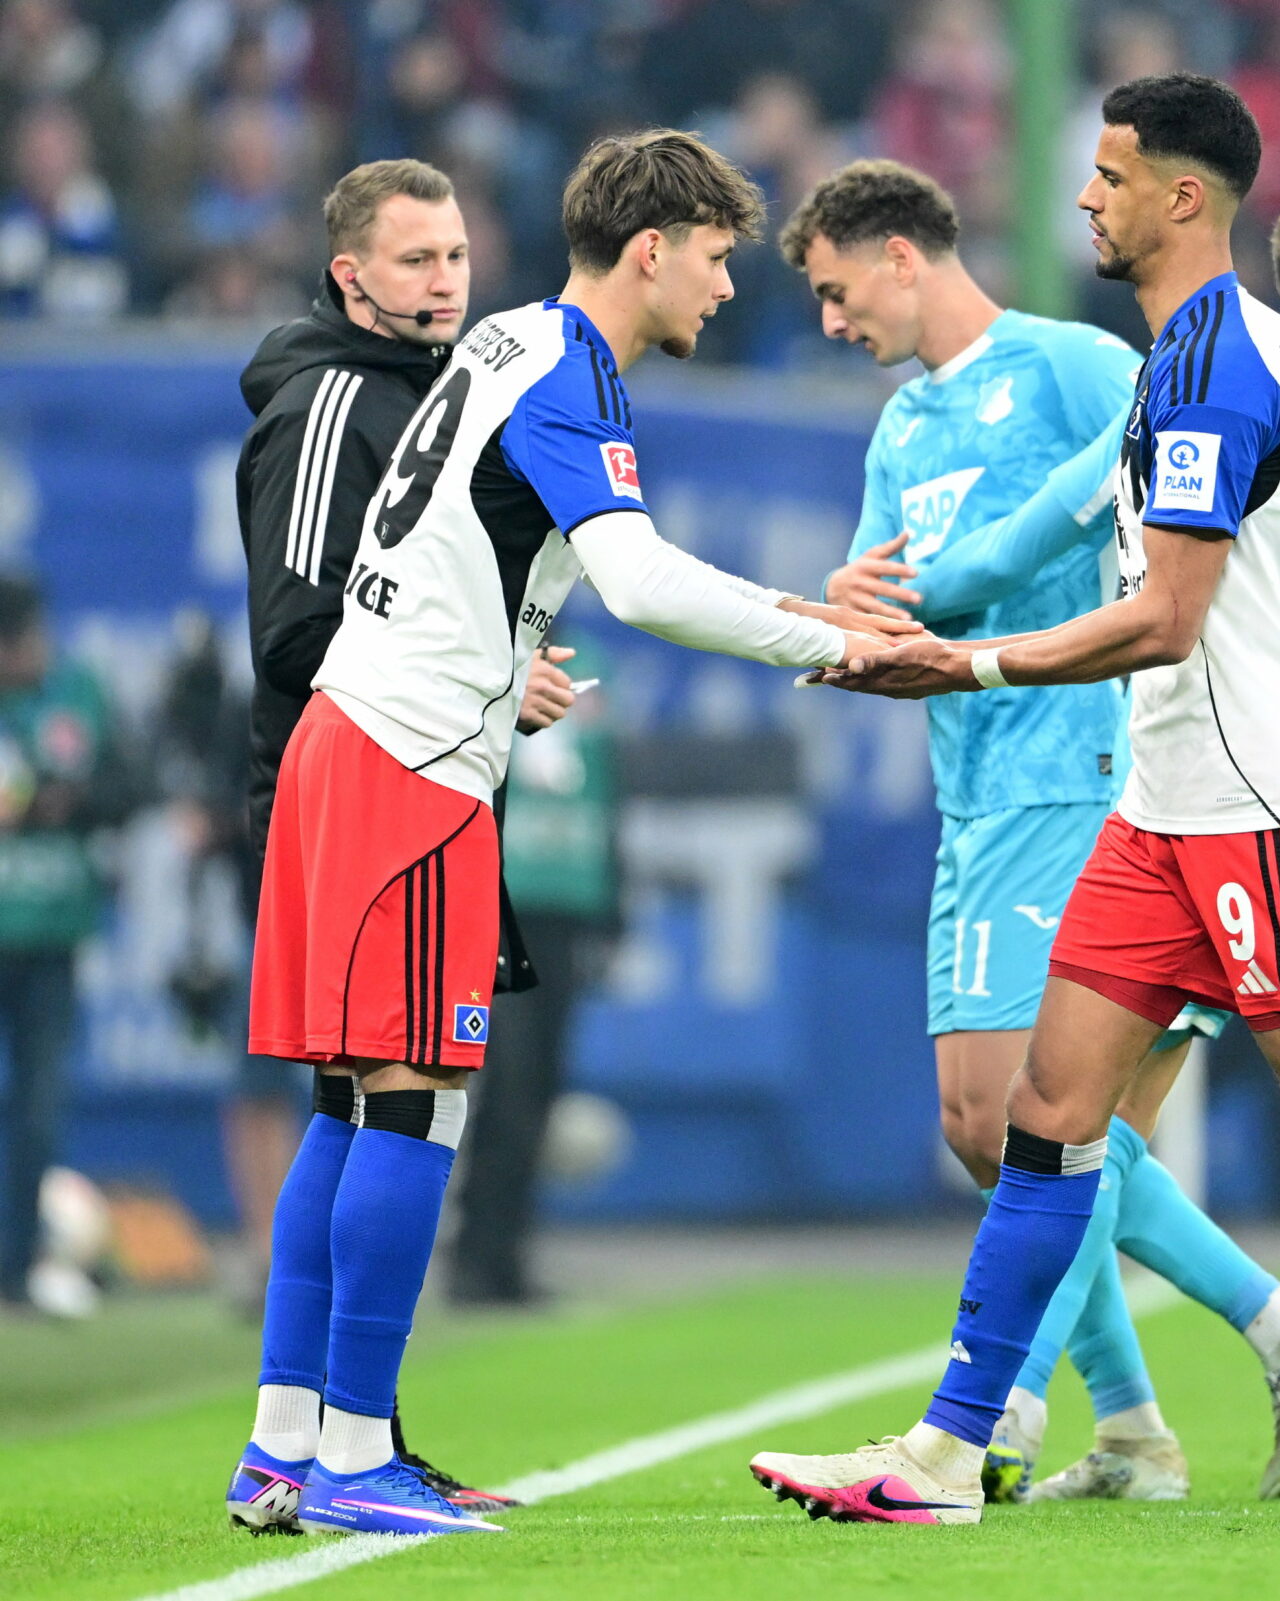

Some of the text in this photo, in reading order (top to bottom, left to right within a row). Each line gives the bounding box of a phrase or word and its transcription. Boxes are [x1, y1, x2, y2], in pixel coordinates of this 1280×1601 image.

[484, 337, 526, 373] SV
[374, 366, 472, 550] 9
[1164, 475, 1203, 491] PLAN
[906, 490, 955, 547] SAP
[1217, 882, 1256, 961] 9
[952, 916, 992, 997] 11
